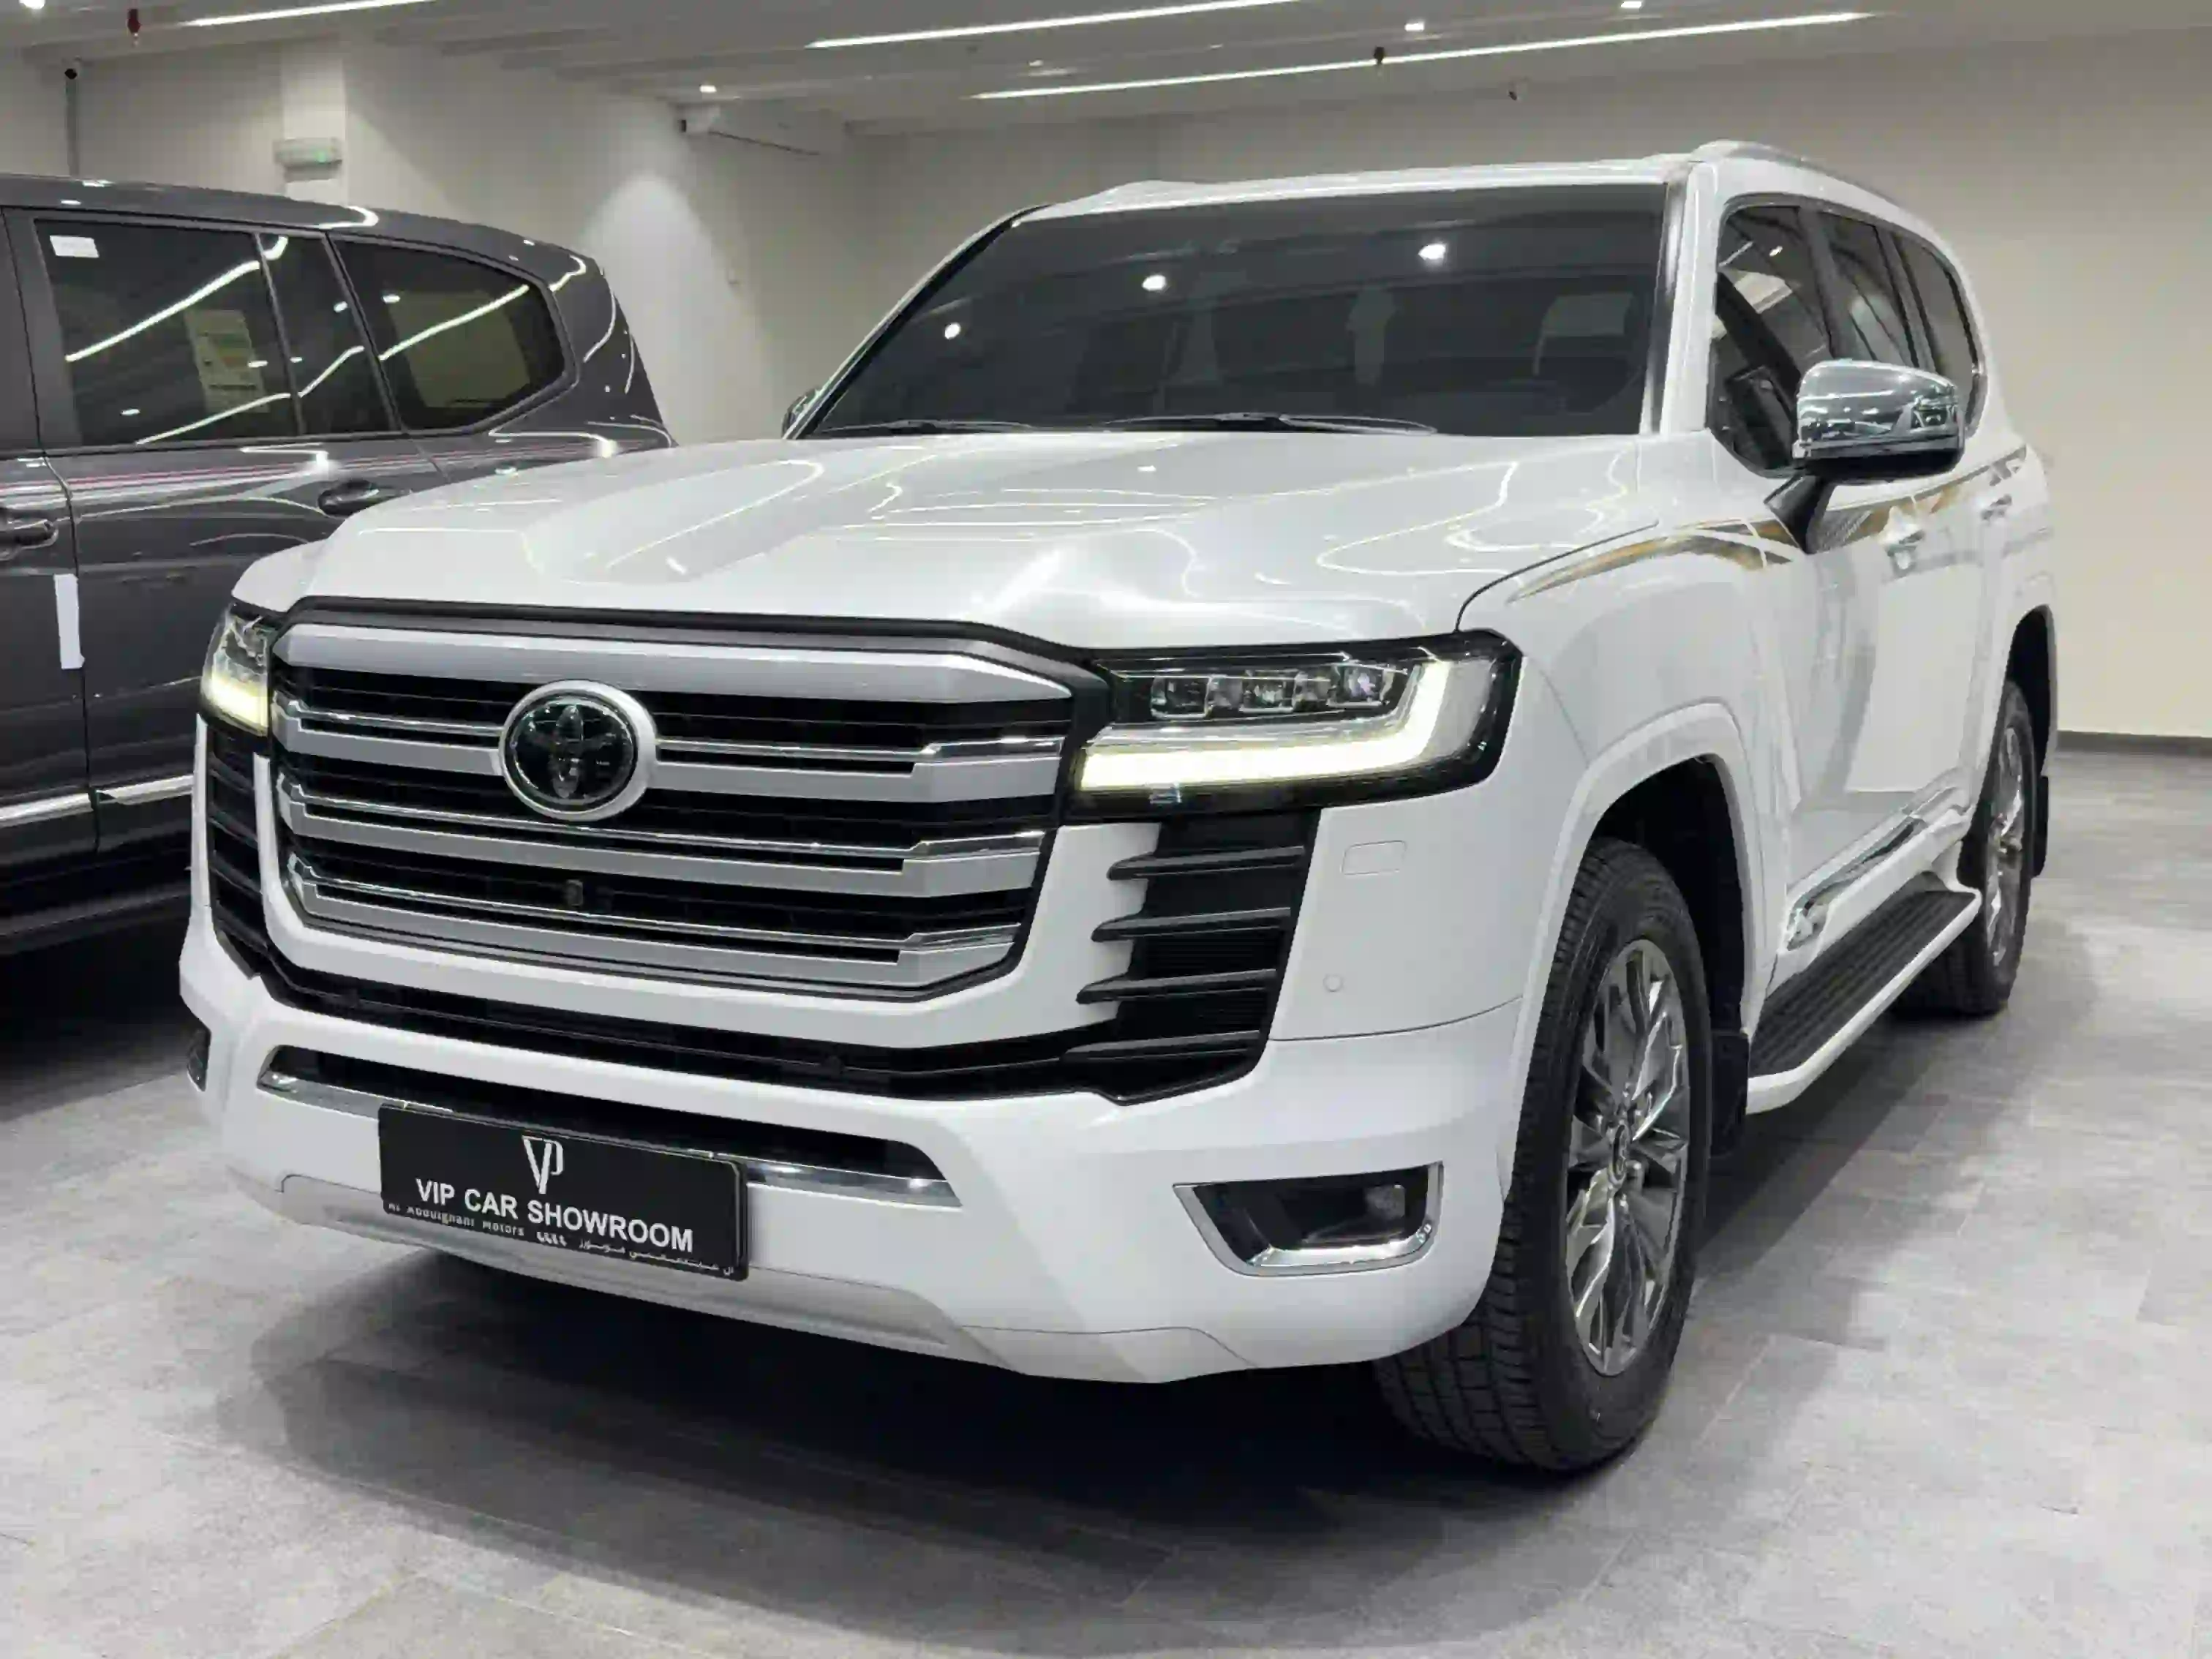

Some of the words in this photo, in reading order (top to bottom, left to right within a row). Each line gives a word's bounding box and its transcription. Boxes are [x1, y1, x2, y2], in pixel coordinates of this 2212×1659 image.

[415, 1178, 455, 1205] VIP
[464, 1188, 519, 1219] CAR
[527, 1200, 693, 1253] SHOWROOM
